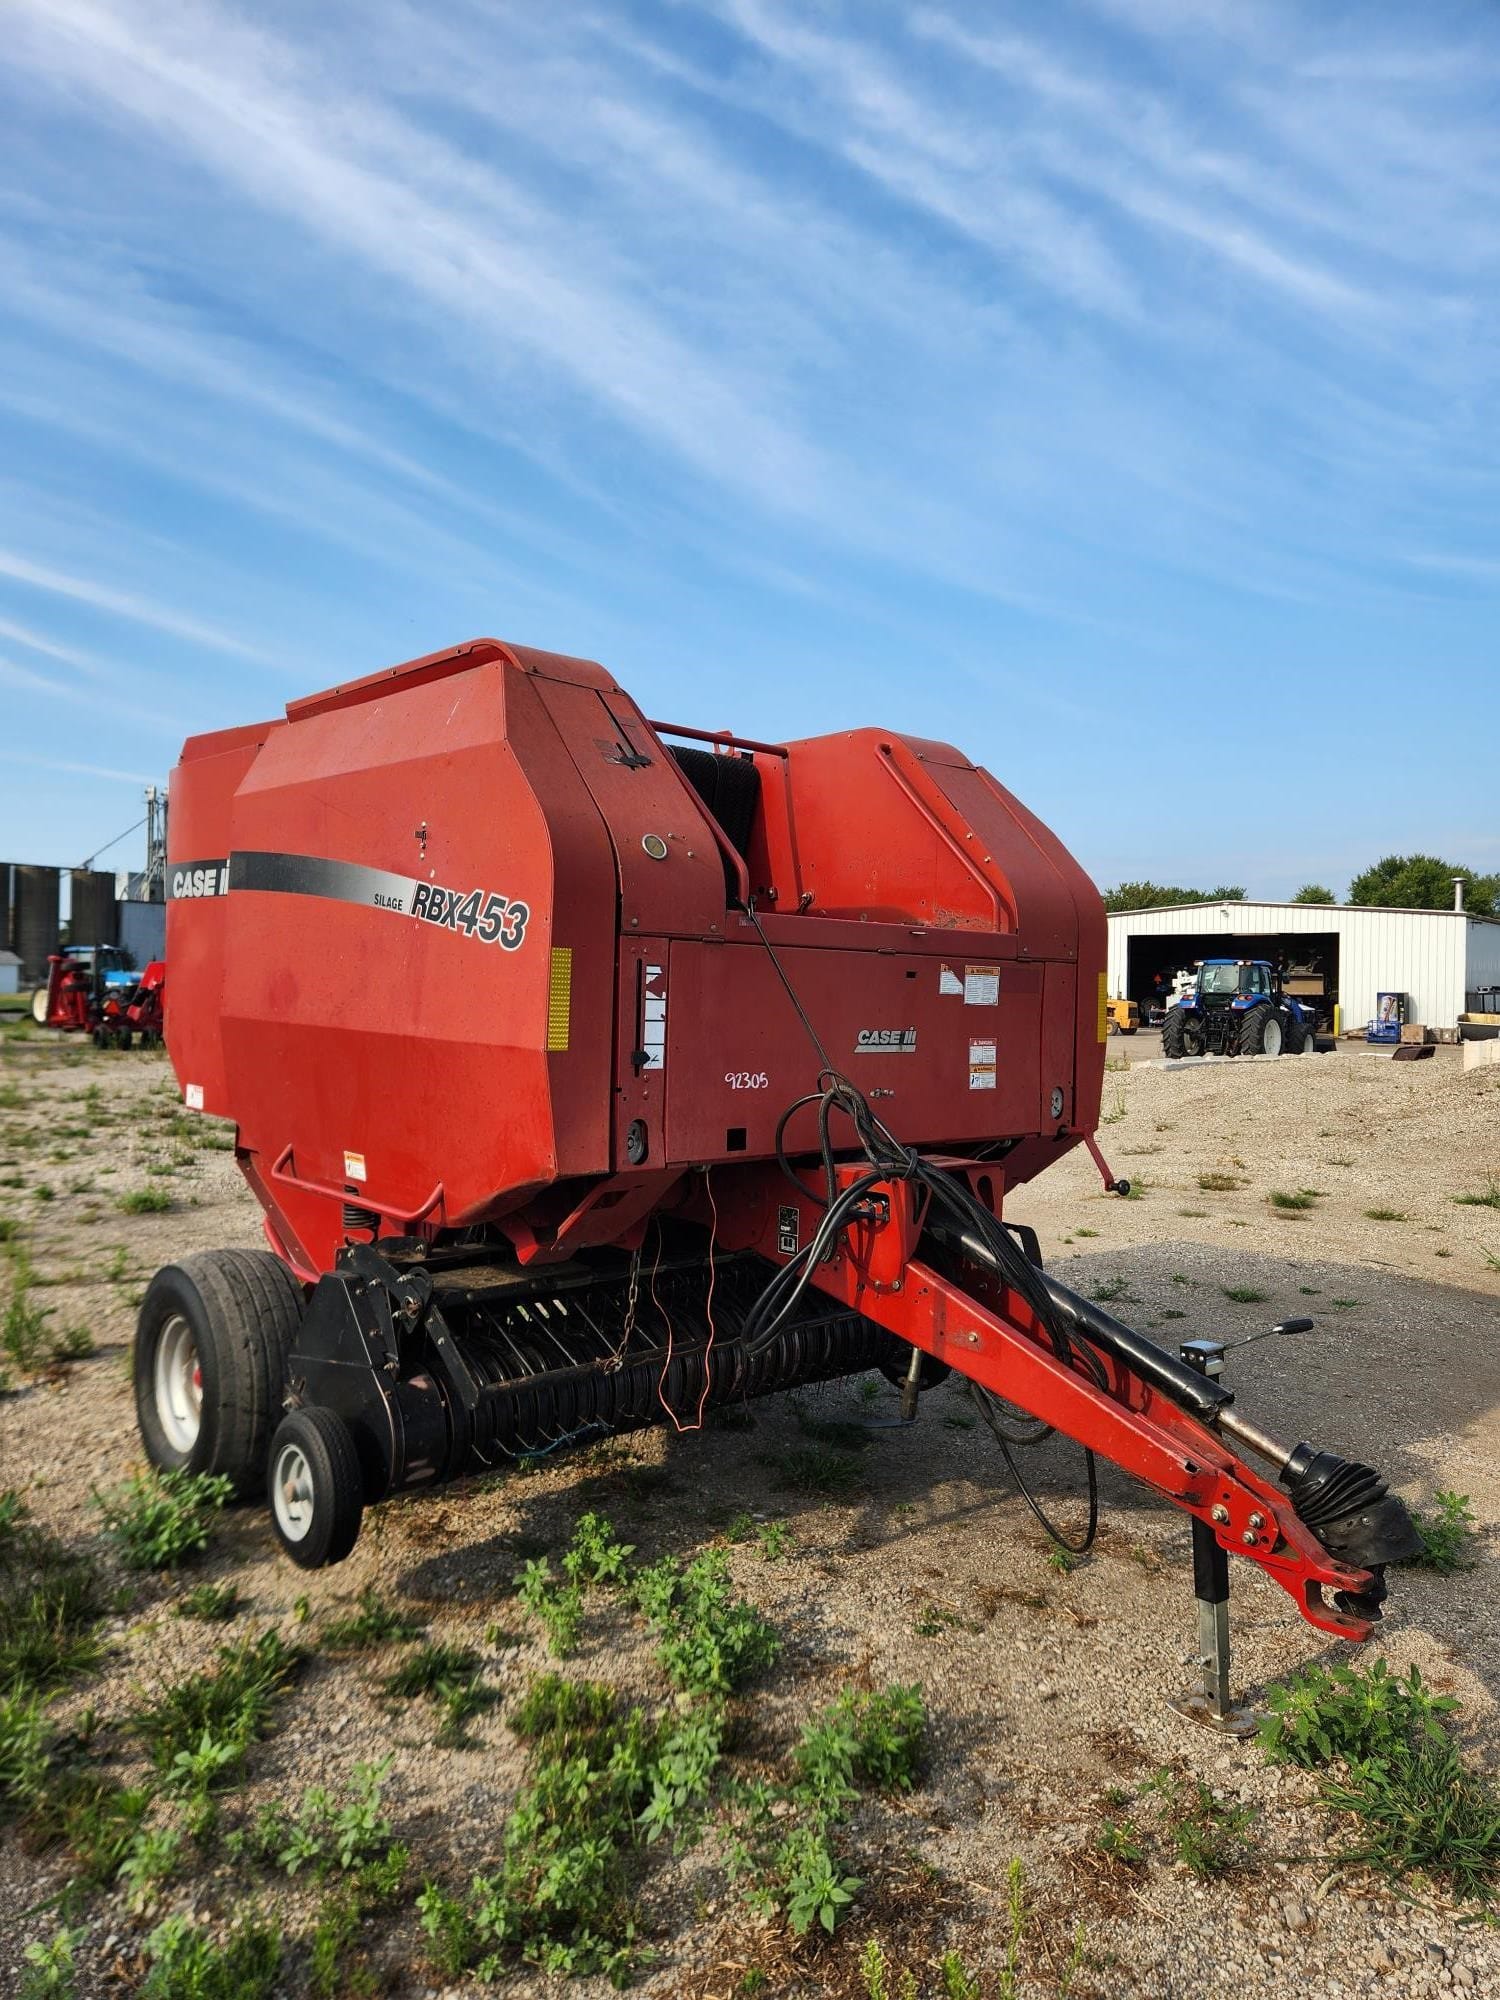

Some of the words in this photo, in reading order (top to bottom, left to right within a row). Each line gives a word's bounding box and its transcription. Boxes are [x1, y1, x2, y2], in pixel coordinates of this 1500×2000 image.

[173, 869, 216, 898] CASE
[374, 893, 403, 911] SILAGE
[410, 881, 530, 951] RBX453
[858, 1029, 901, 1045] CASE
[724, 1071, 769, 1090] 92305
